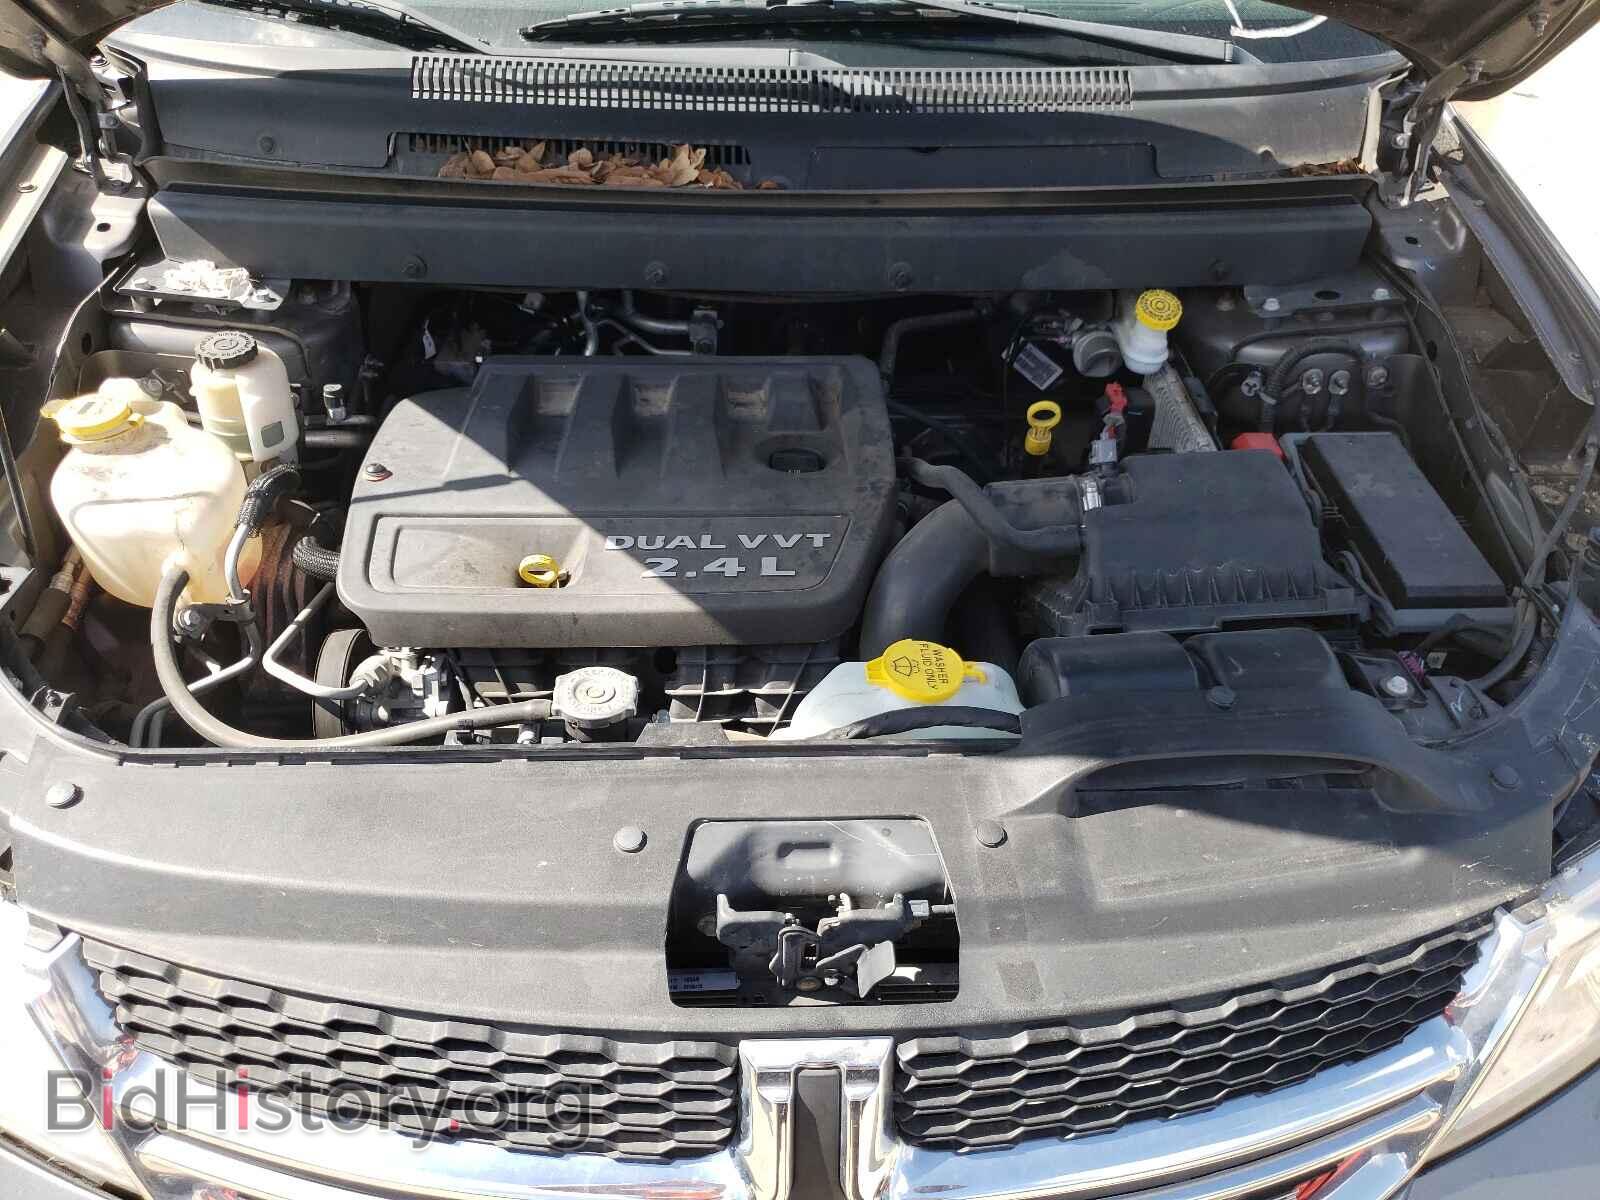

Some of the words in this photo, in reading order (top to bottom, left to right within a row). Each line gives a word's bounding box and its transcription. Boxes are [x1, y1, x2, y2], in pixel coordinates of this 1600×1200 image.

[605, 534, 726, 551] DUAL
[737, 533, 831, 549] VVT
[919, 643, 931, 667] FLUID
[925, 668, 938, 690] ONLY
[932, 649, 949, 684] WASHER
